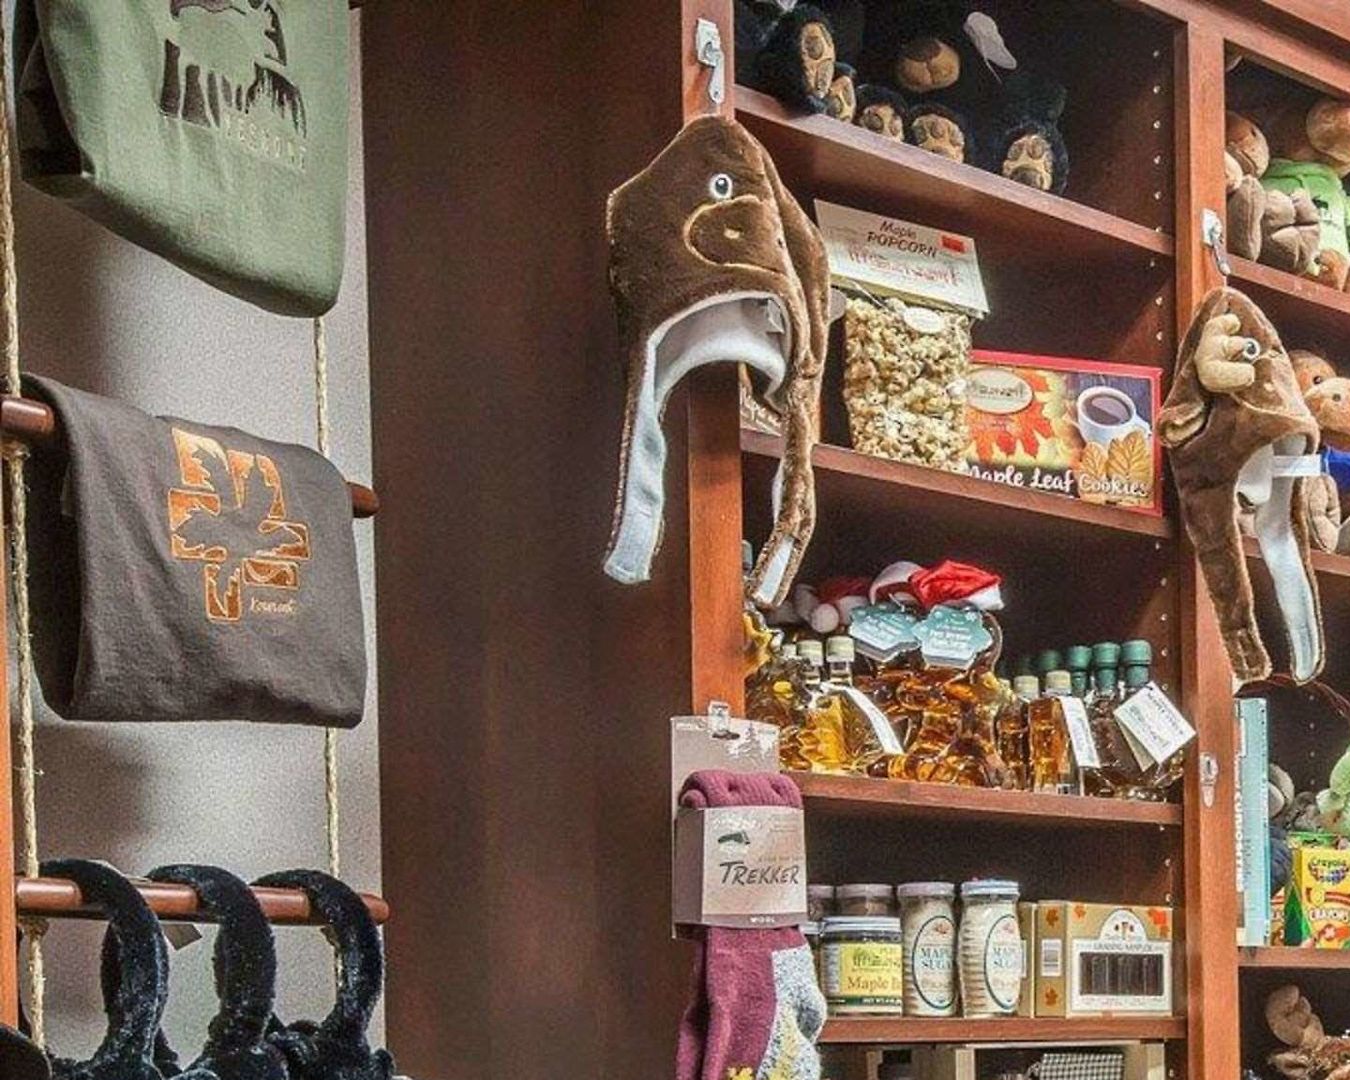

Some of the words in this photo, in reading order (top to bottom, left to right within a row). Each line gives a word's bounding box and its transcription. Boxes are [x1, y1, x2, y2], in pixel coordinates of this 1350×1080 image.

[879, 220, 918, 239] Maple
[867, 231, 937, 258] POPCORN
[1030, 468, 1074, 492] Leaf
[1079, 474, 1149, 496] Cookies
[718, 860, 800, 886] TREKKER
